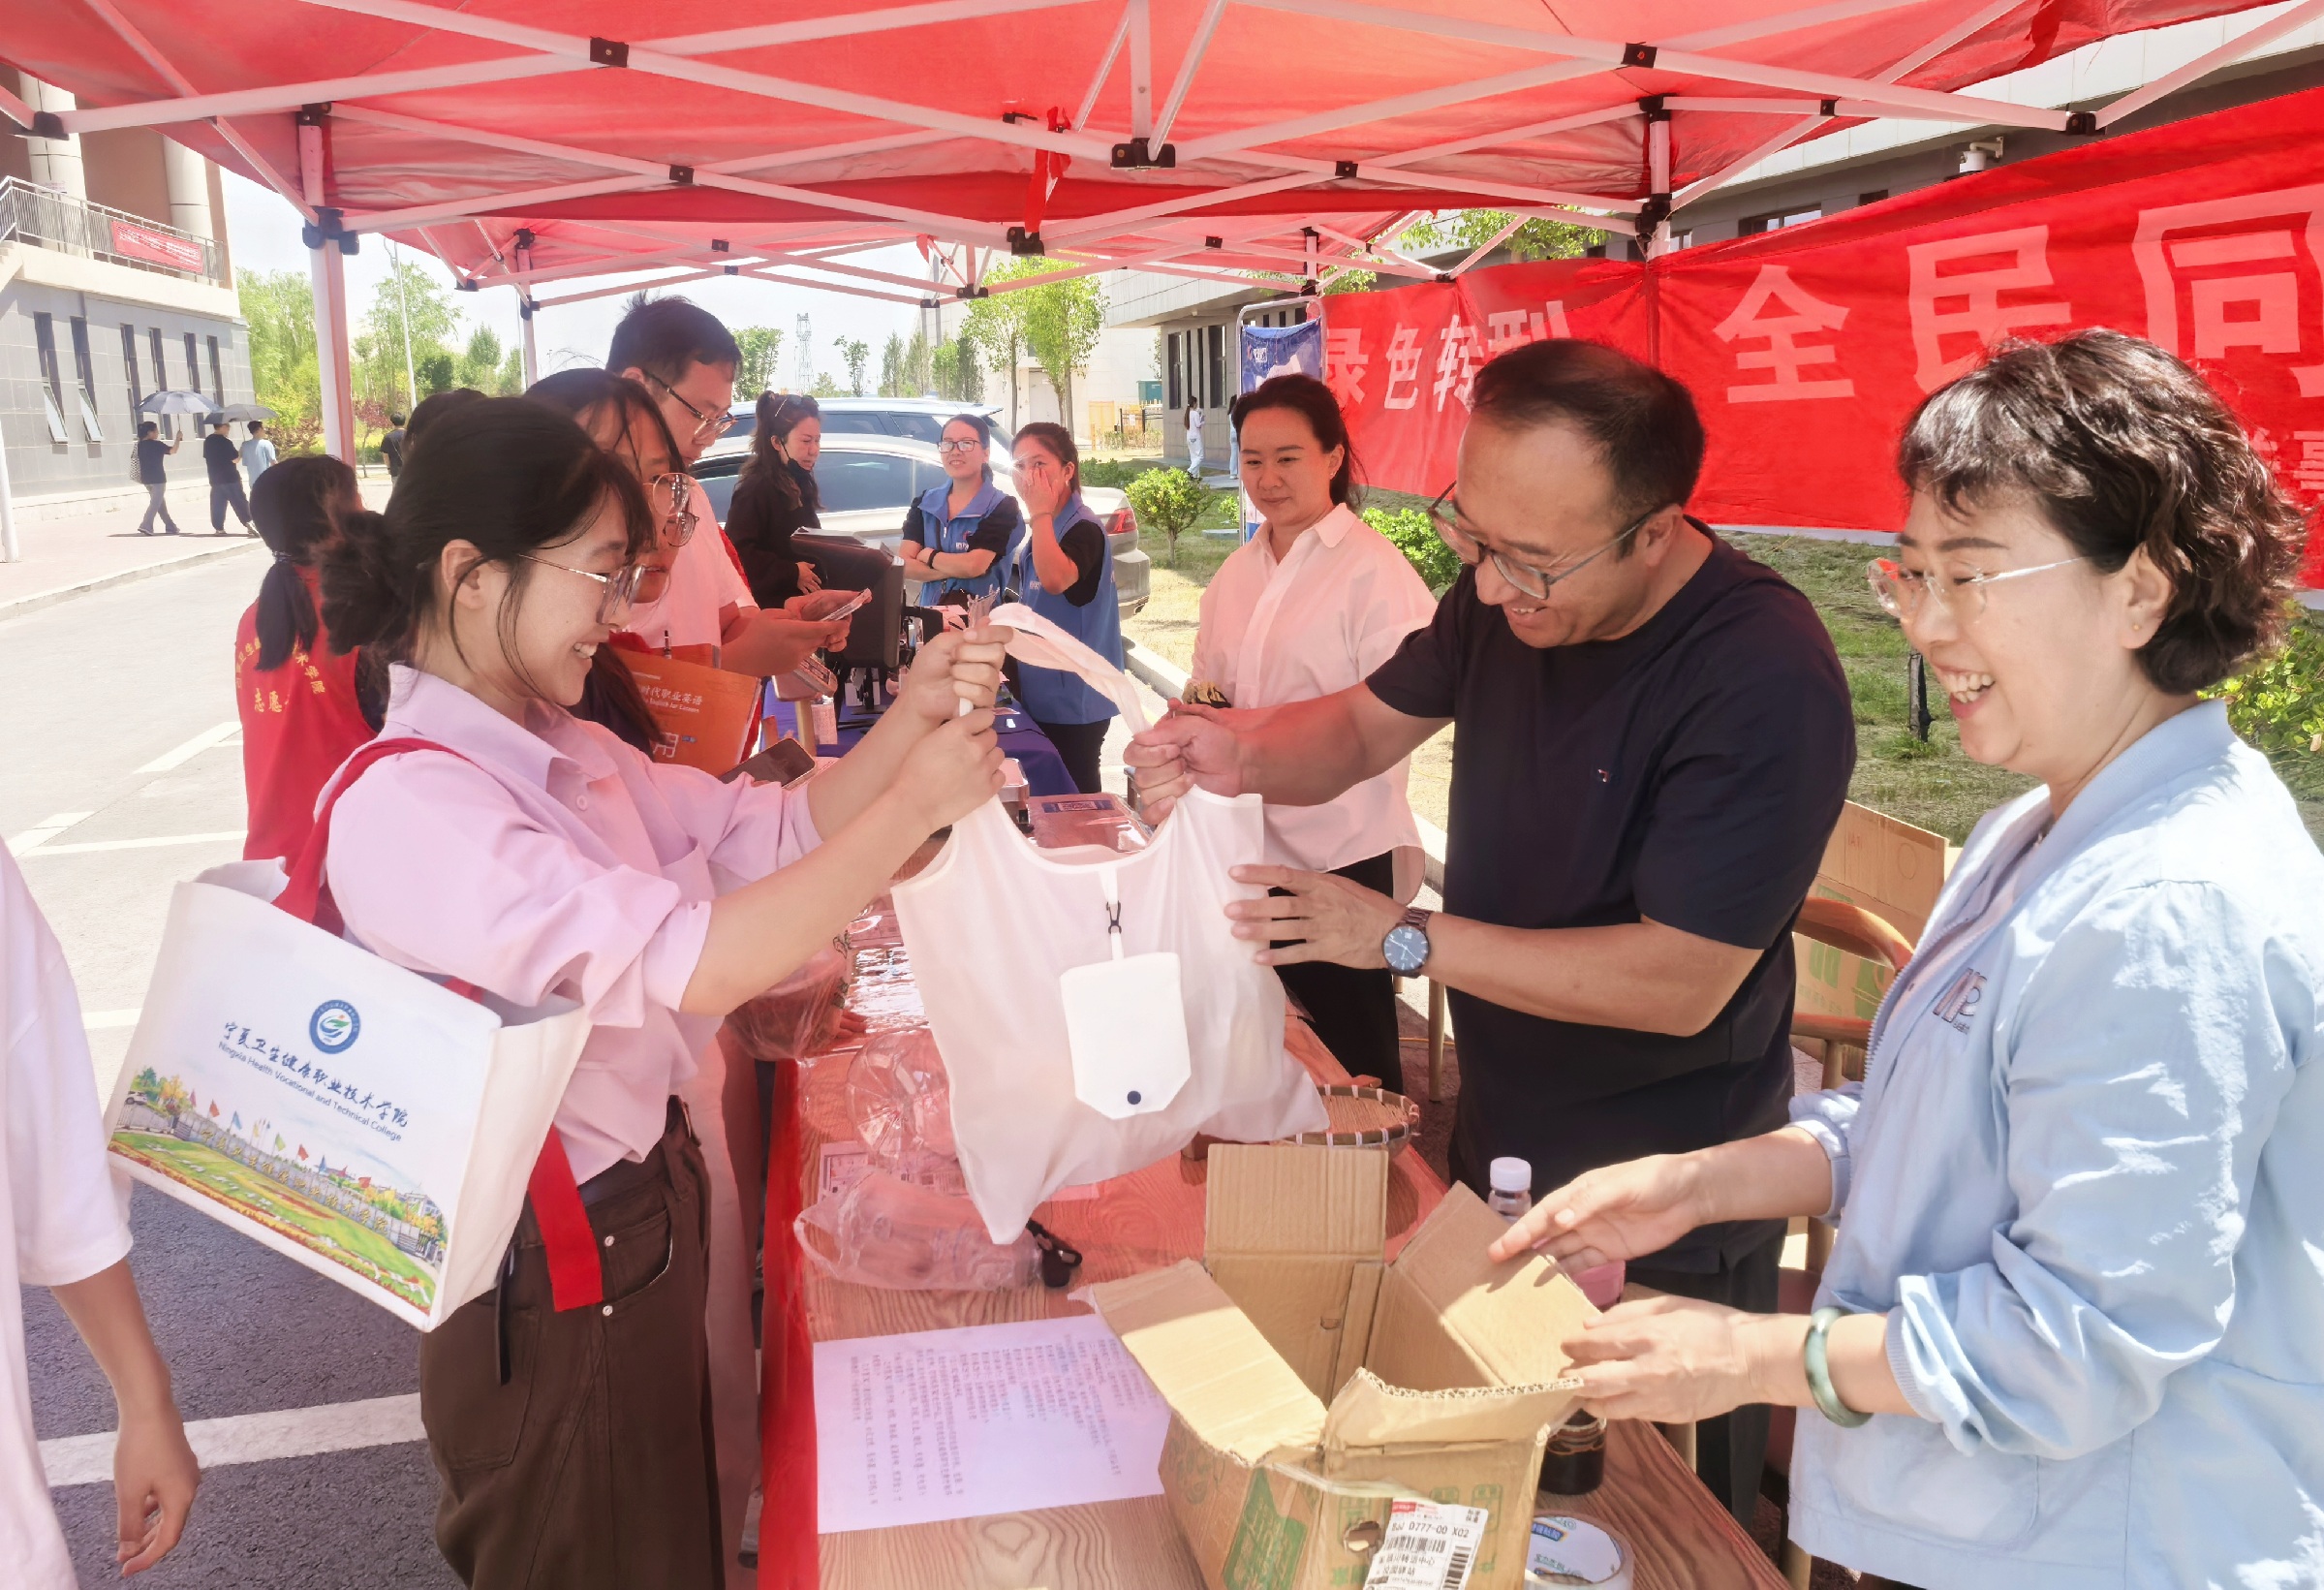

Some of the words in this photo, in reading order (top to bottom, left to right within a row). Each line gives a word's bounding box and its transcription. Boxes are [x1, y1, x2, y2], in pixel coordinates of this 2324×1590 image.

[254, 687, 290, 713] 志愿
[218, 1041, 247, 1062] Ningxia
[247, 1053, 273, 1076] Health
[274, 1070, 316, 1099] Vocational
[315, 1094, 331, 1107] and
[333, 1101, 369, 1126] Technical
[370, 1120, 402, 1142] College
[224, 1021, 409, 1128] 宁夏卫生健康职业技术学院
